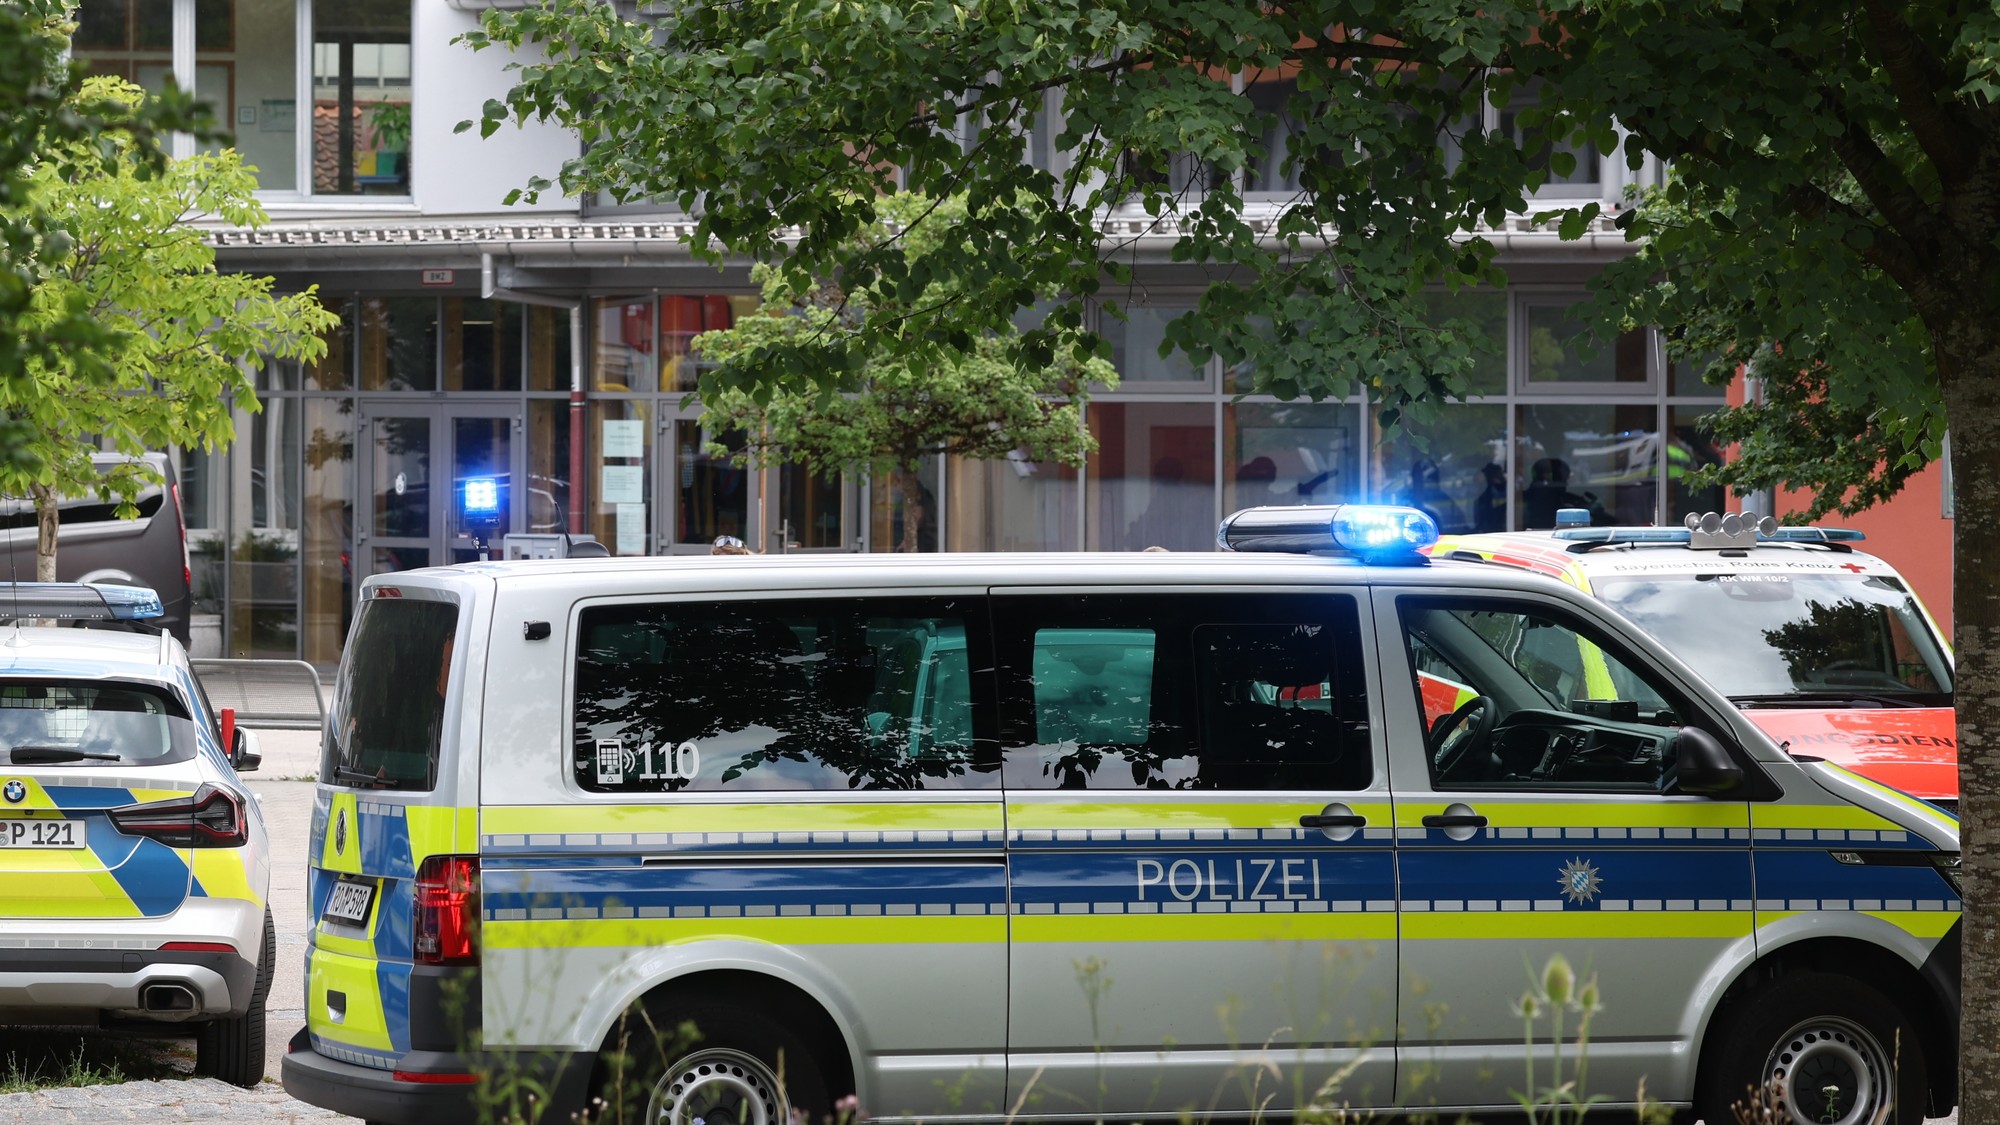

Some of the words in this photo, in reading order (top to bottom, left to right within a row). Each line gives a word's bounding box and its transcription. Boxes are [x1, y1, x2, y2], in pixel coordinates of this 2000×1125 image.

[1614, 561, 1724, 572] Bayerisches
[1729, 561, 1780, 569] Rotes
[1786, 561, 1835, 569] Kreuz
[1718, 575, 1738, 583] RK
[1739, 575, 1763, 583] WM
[1764, 575, 1790, 583] 10/2
[1775, 733, 1958, 749] UNGSDIEN
[638, 741, 700, 780] 110
[11, 822, 26, 845] P
[32, 822, 75, 845] 121
[1136, 858, 1320, 901] POLIZEI
